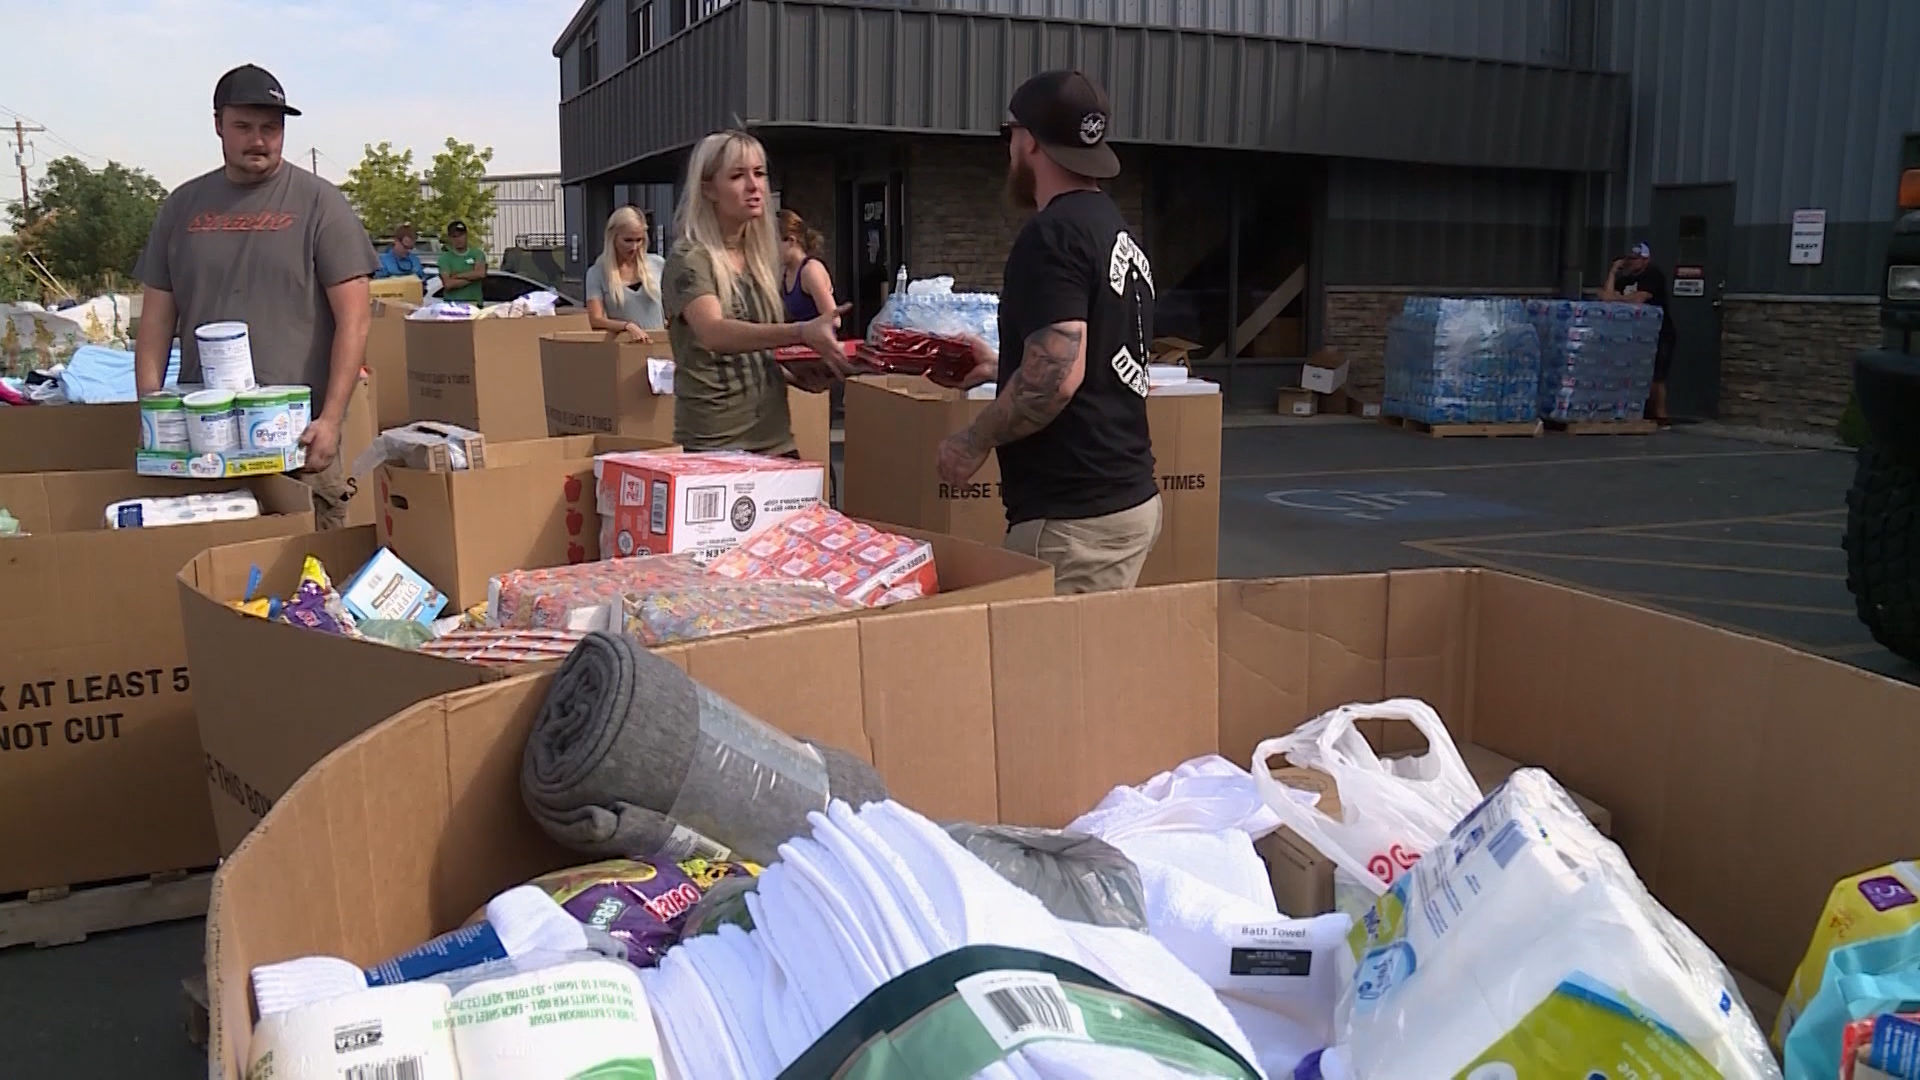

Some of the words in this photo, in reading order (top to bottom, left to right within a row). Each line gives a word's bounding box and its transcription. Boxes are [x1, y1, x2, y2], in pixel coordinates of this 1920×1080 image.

[938, 482, 991, 499] REUSE
[1161, 474, 1206, 491] TIMES
[18, 681, 56, 710] AT
[67, 669, 163, 704] LEAST
[172, 667, 190, 693] 5
[64, 713, 124, 744] CUT
[1241, 926, 1268, 937] Bath
[1272, 927, 1306, 938] Towel
